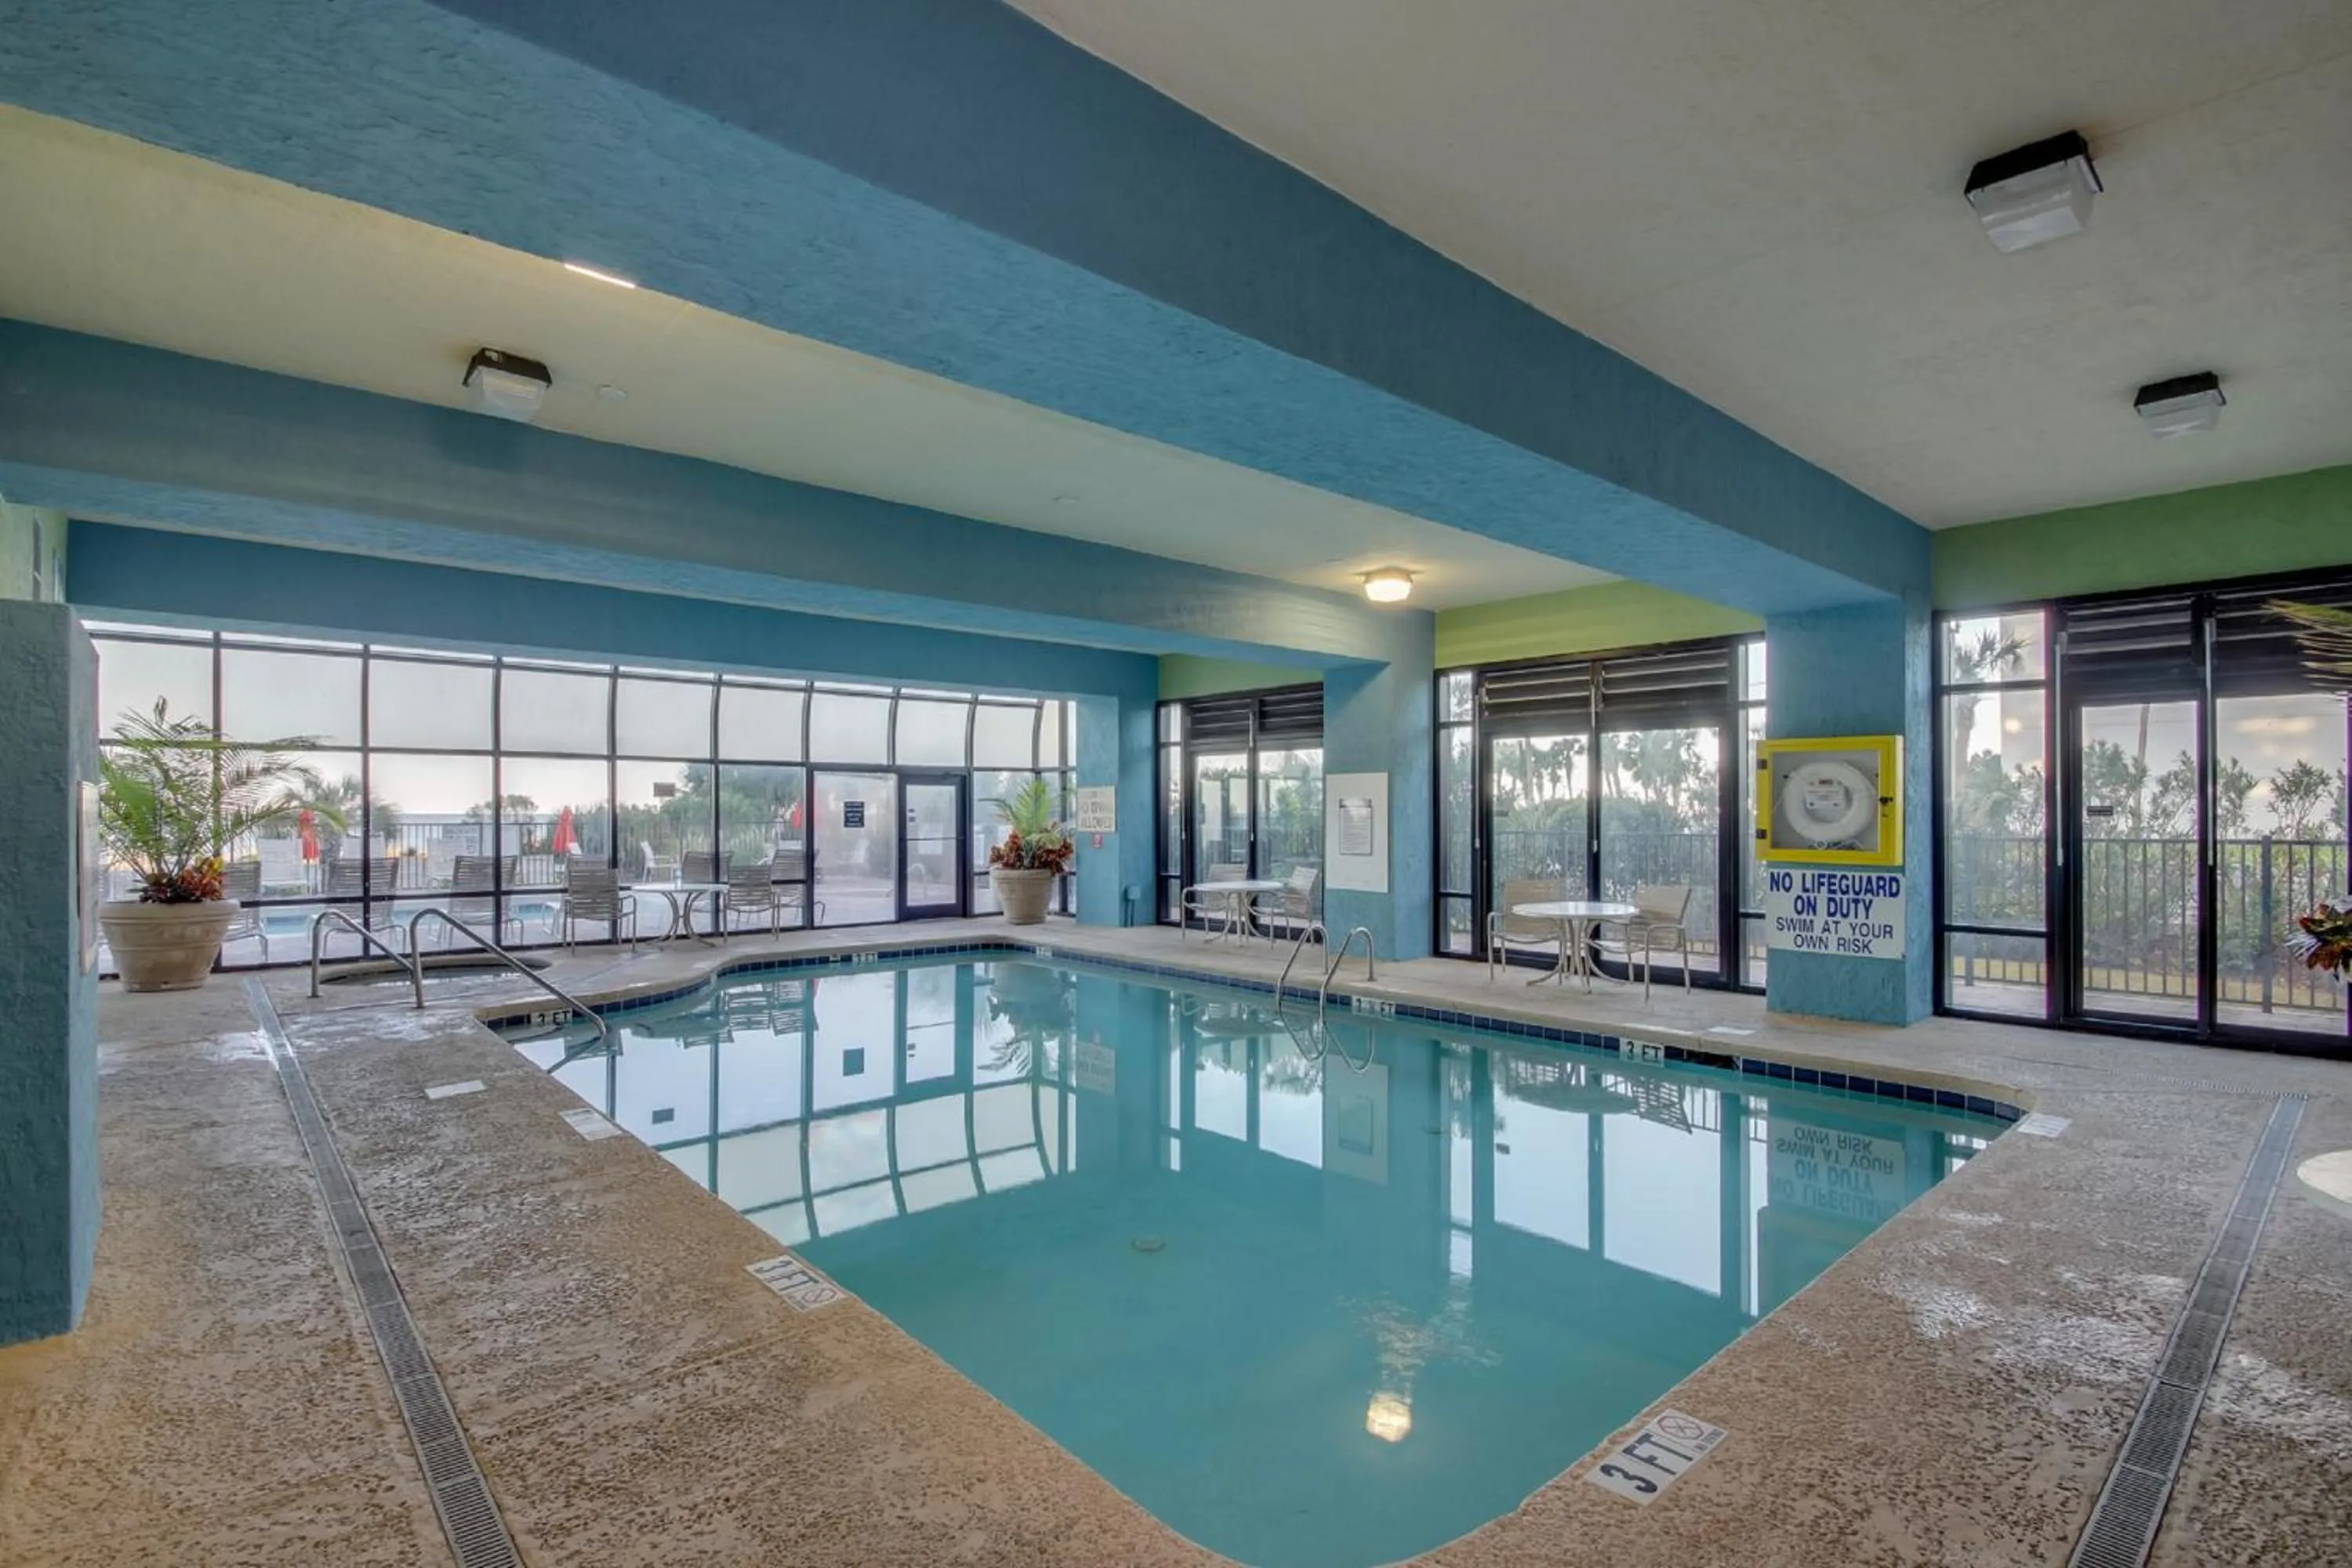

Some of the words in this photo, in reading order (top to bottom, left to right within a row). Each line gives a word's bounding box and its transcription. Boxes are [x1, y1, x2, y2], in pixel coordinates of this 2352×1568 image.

[1769, 872, 1793, 893] NO
[1802, 873, 1900, 898] LIFEGUARD
[1794, 895, 1817, 916] ON
[1827, 897, 1873, 920] DUTY
[1776, 916, 1815, 934] SWIM
[1821, 920, 1841, 936] AT
[1849, 922, 1894, 940] YOUR
[1793, 934, 1829, 951] OWN
[1837, 937, 1873, 955] RISK
[1622, 1432, 1693, 1475] FT
[1599, 1464, 1658, 1494] 3
